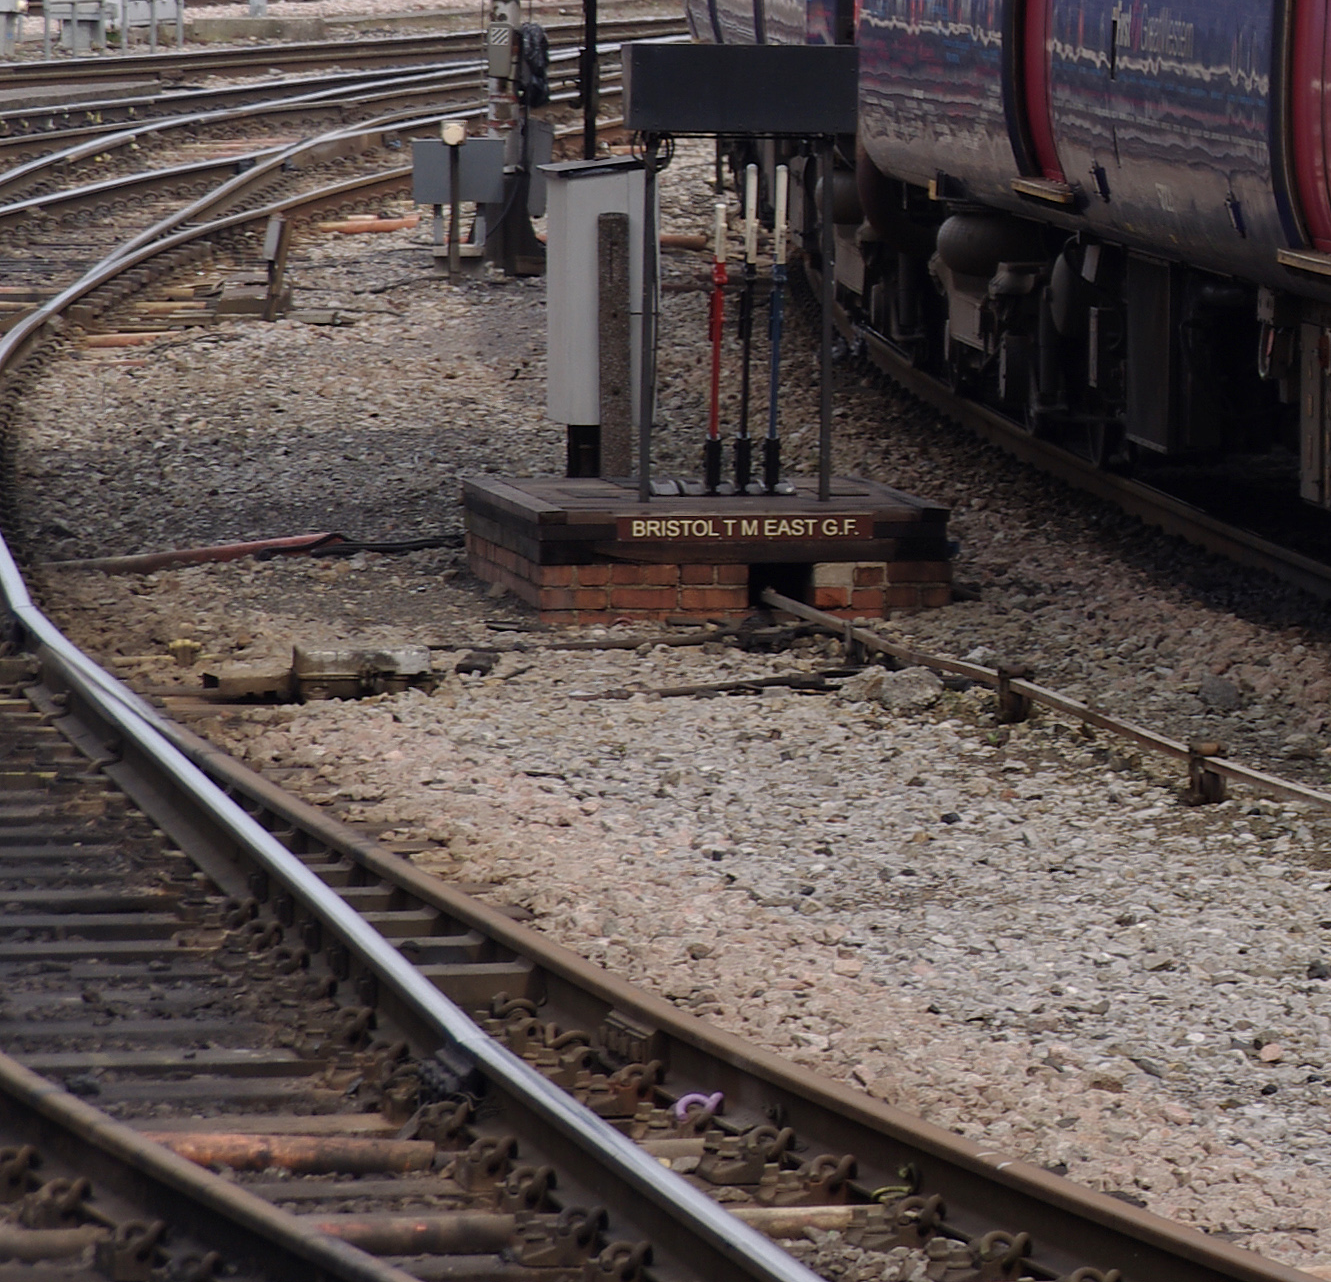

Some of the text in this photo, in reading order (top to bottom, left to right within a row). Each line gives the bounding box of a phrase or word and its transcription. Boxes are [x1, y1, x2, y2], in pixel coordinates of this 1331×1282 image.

[631, 519, 860, 538] BRISTOL T M EAST G.F.
